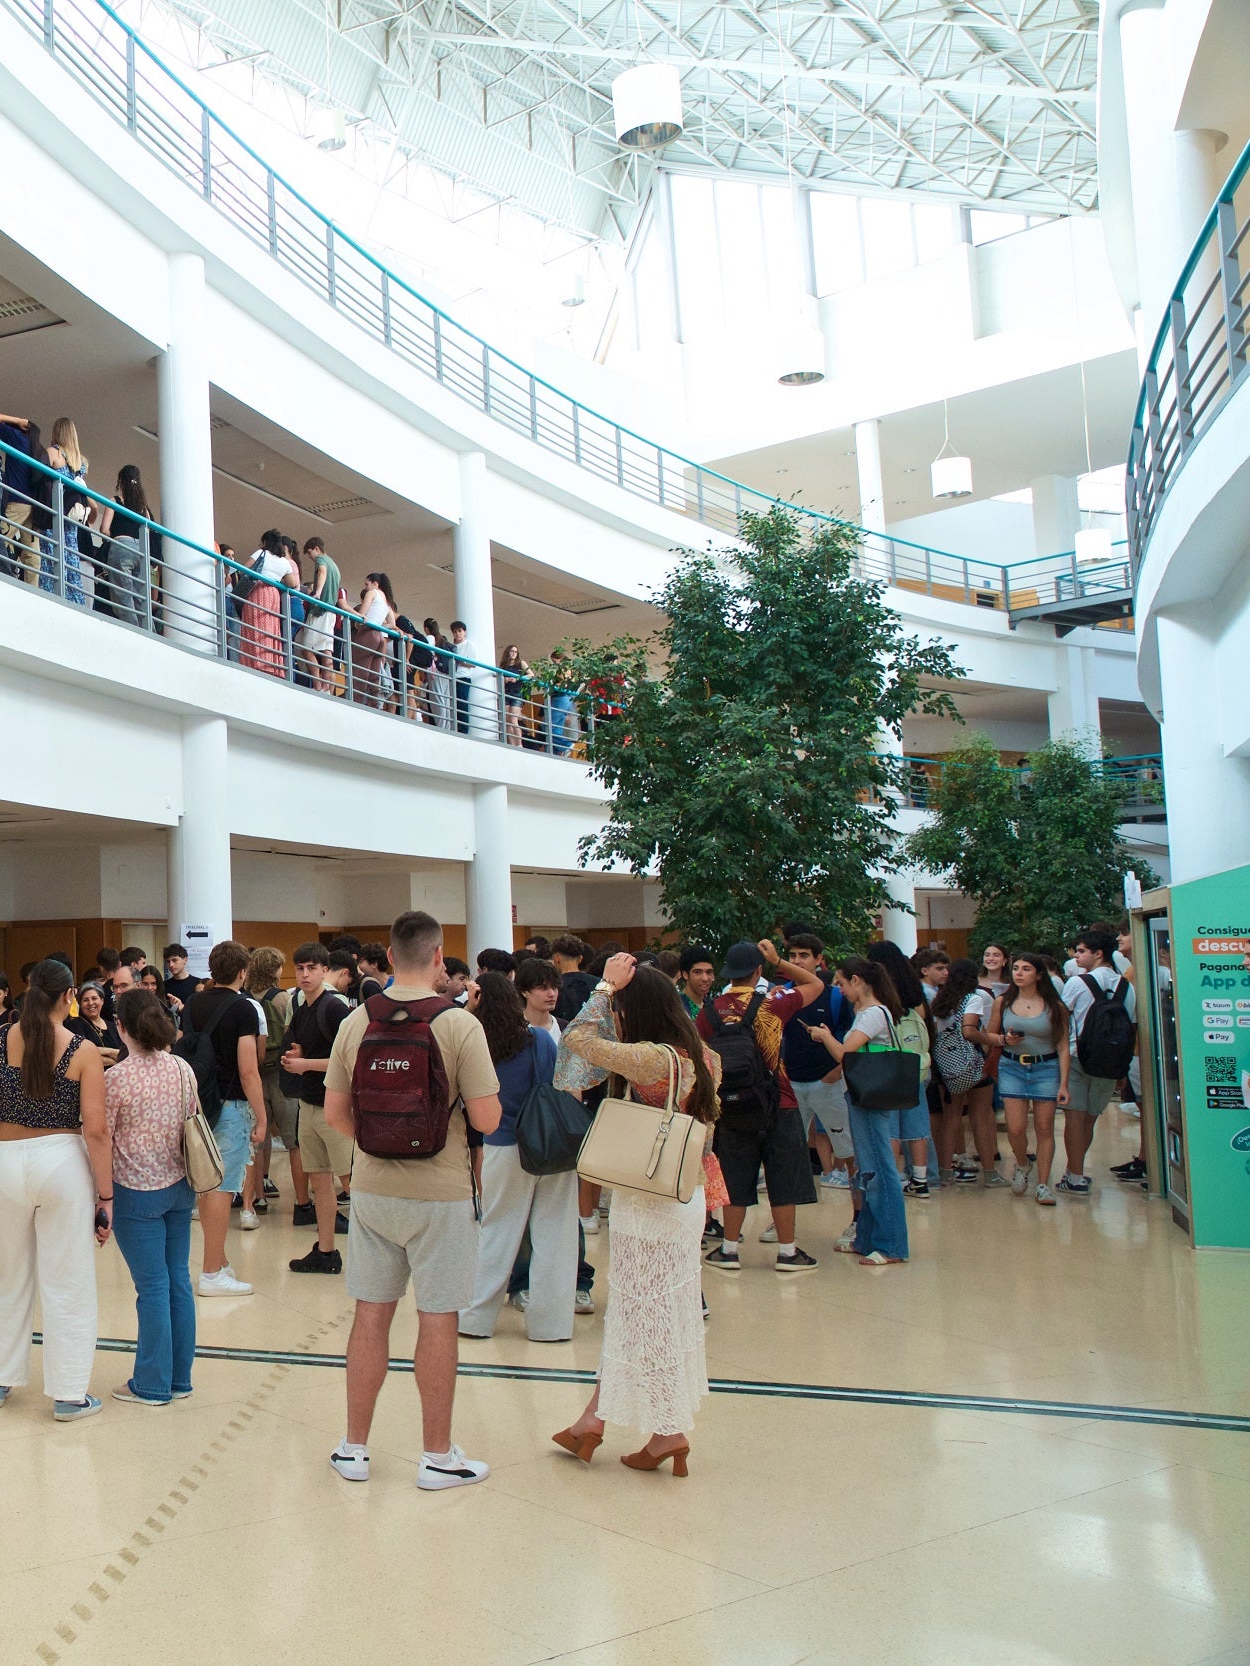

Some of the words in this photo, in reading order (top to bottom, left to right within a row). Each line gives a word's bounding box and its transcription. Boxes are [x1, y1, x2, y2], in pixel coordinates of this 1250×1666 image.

[1200, 974, 1237, 990] App
[1215, 1017, 1229, 1025] Pay
[1215, 1033, 1230, 1042] Pay
